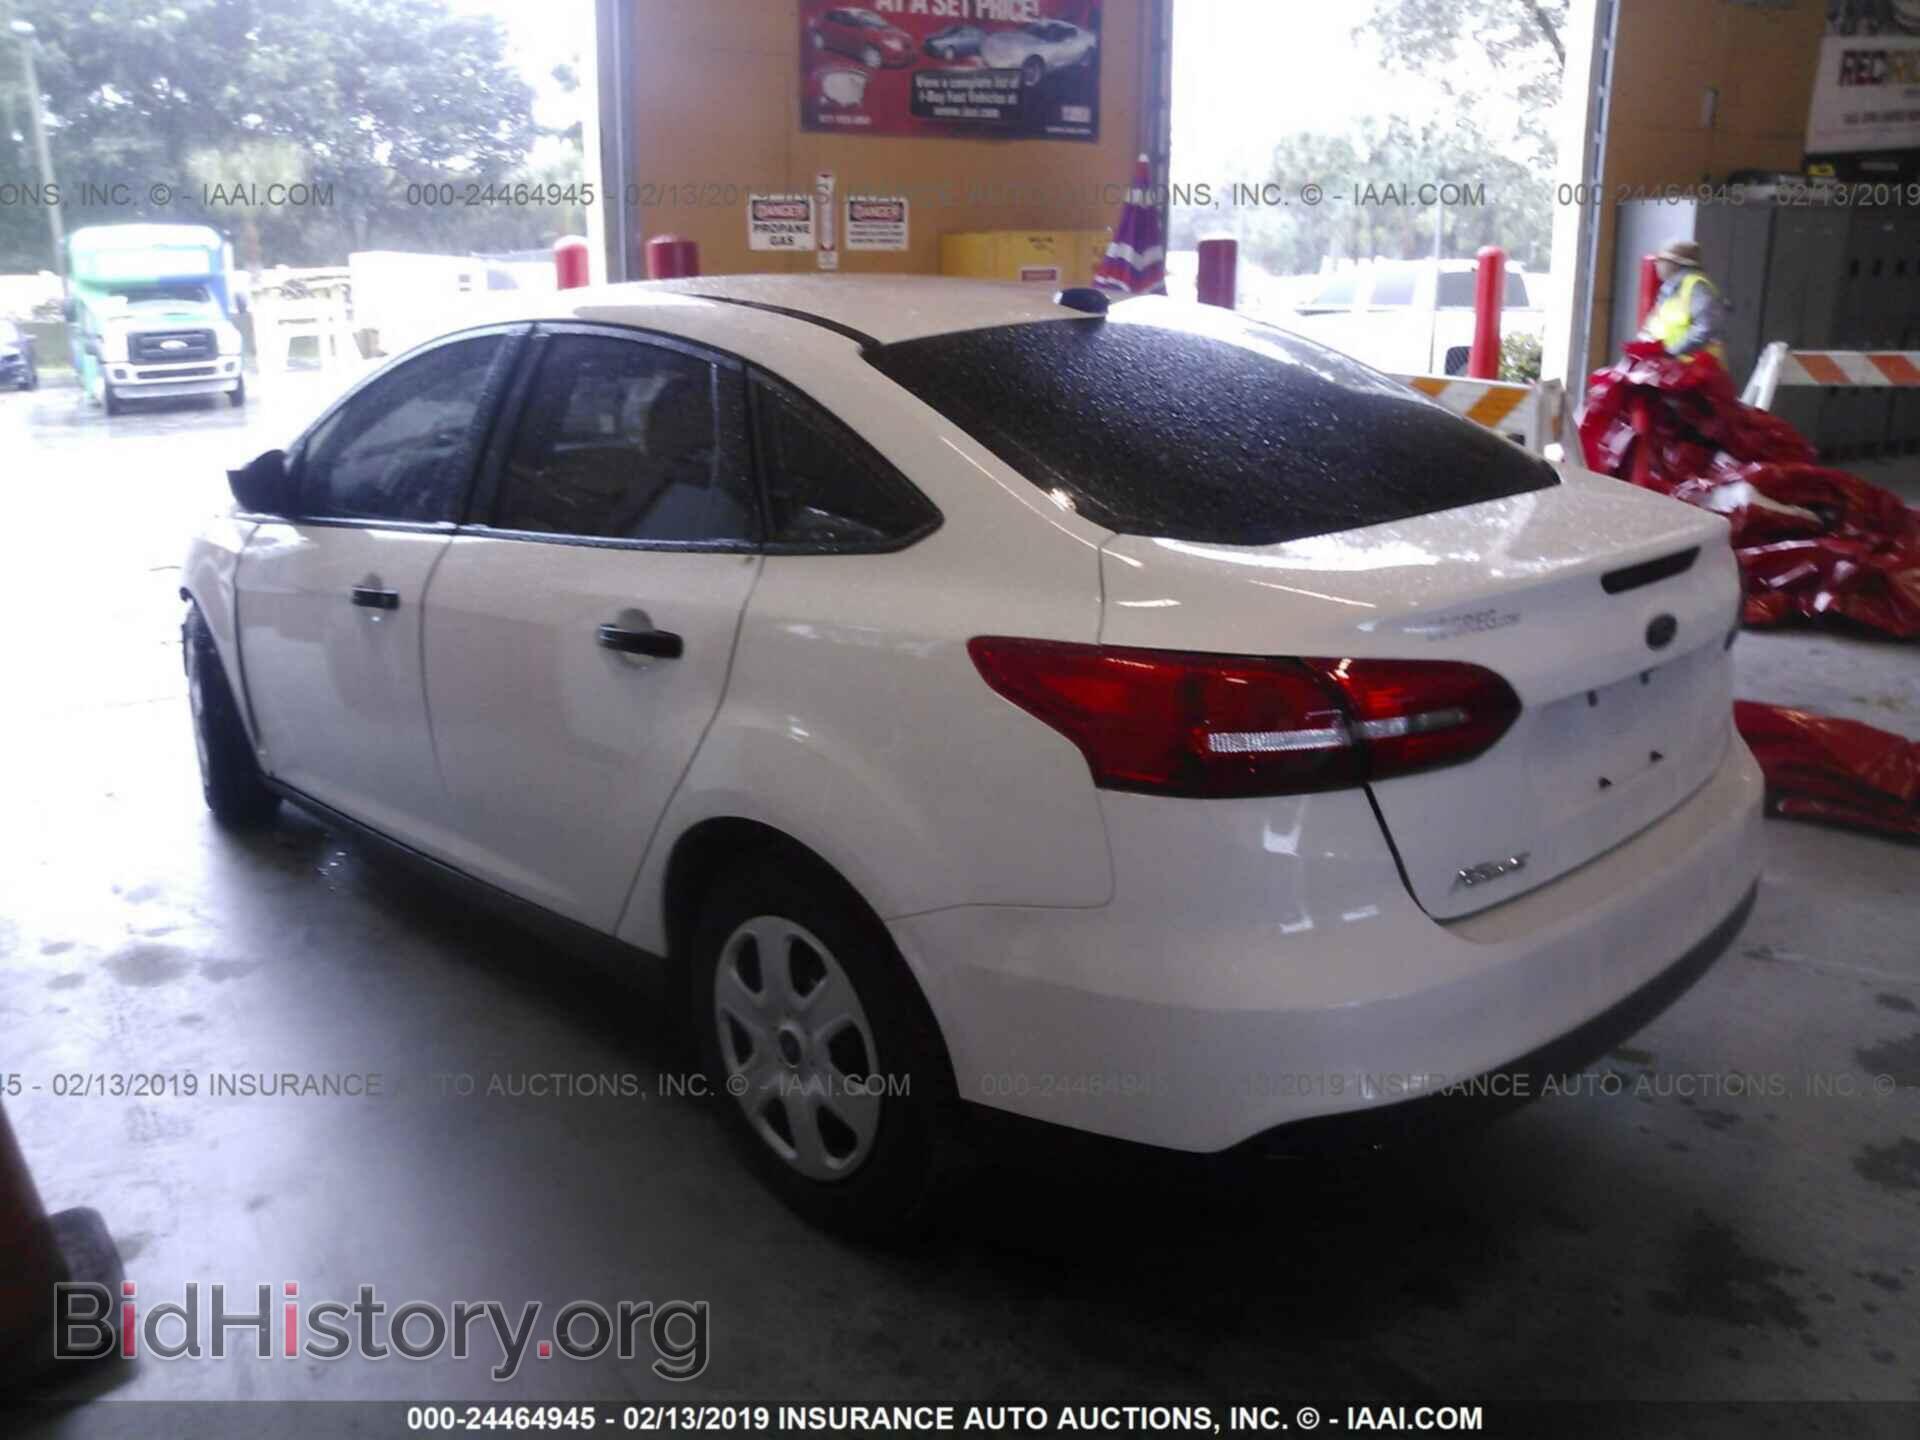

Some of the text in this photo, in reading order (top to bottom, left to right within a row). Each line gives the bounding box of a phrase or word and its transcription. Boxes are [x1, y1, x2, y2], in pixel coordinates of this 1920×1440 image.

[910, 0, 928, 14] A
[932, 0, 970, 18] SET
[752, 223, 811, 234] PROPANE
[769, 236, 795, 246] GAS
